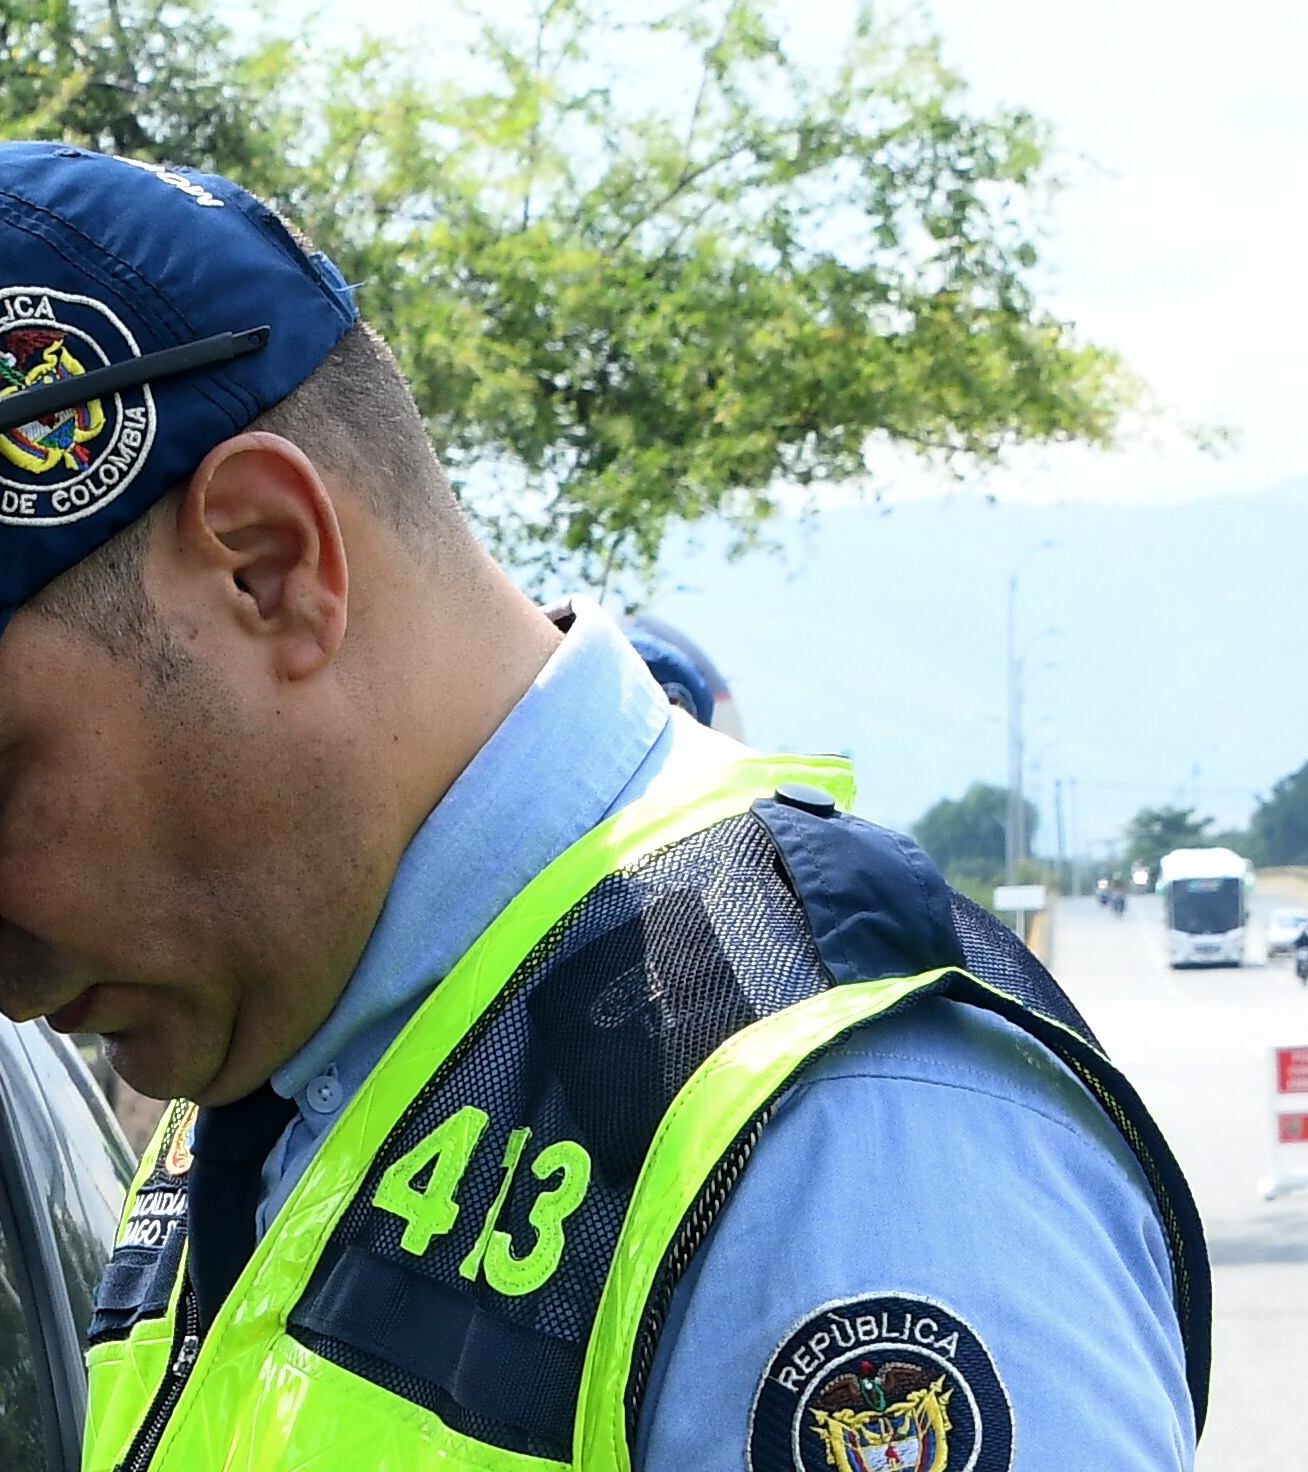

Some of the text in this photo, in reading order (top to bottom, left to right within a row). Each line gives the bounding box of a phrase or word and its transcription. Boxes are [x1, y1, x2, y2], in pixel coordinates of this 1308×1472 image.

[1, 406, 146, 514] DE COLOMBIA
[372, 1105, 592, 1297] 413
